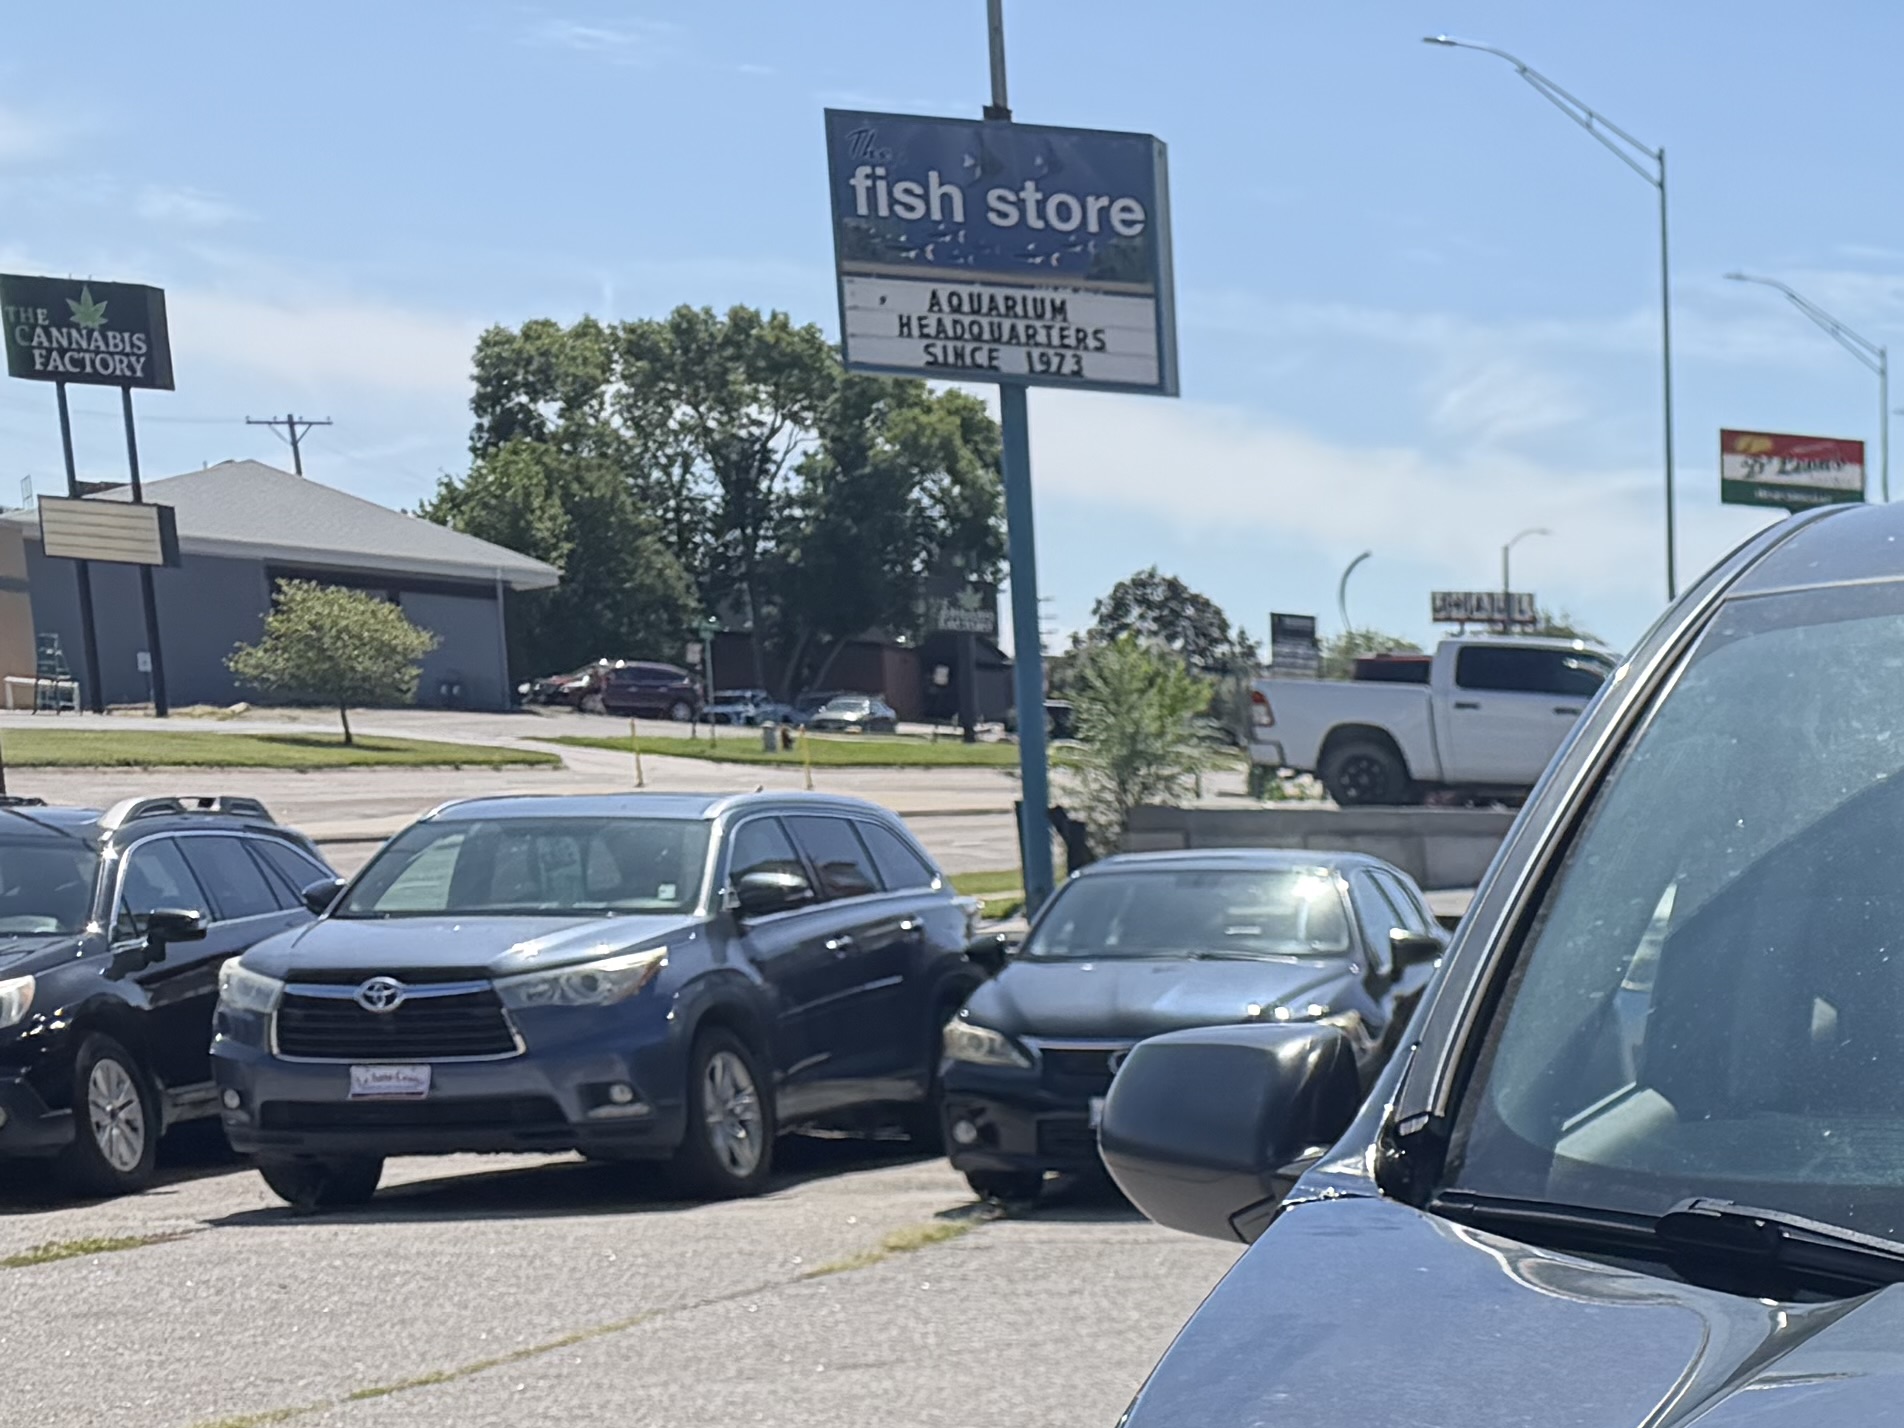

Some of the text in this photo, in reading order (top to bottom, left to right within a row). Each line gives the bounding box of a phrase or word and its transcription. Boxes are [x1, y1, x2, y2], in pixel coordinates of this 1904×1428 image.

[849, 165, 1147, 237] fish store
[4, 306, 50, 326] THE
[927, 288, 1069, 323] AQUARIUM
[14, 325, 148, 355] CANNABIS
[898, 314, 1108, 352] HEADQUARTERS
[32, 348, 147, 378] FACTORY
[922, 342, 1085, 379] SINCE 1973
